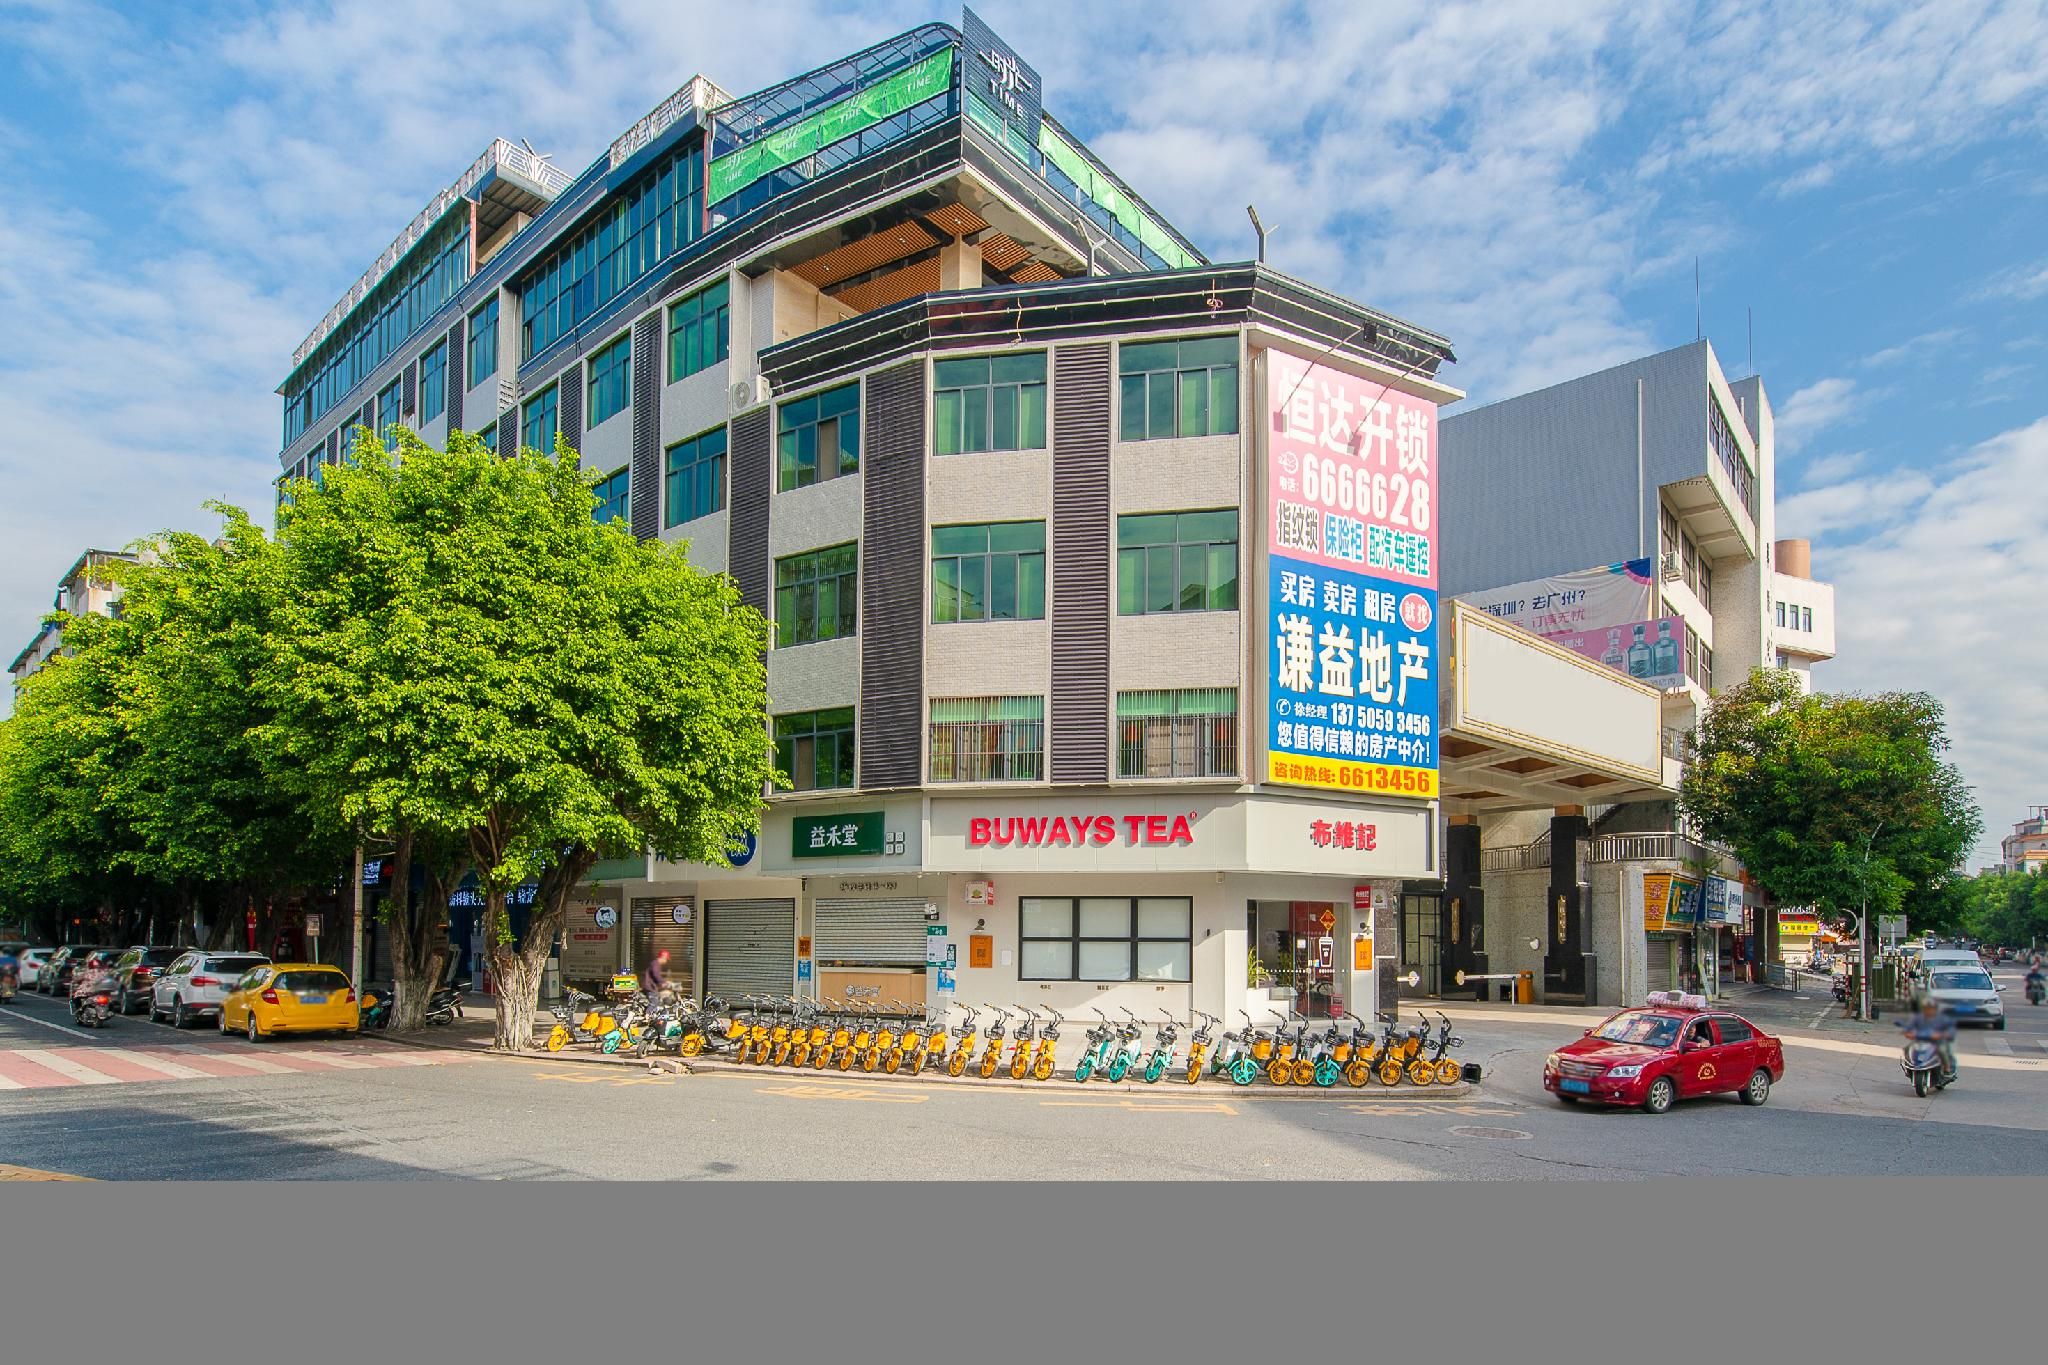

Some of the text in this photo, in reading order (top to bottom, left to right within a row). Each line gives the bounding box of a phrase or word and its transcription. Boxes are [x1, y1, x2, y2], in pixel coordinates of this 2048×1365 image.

[990, 79, 1024, 118] TIME
[1277, 367, 1430, 478] 恒达开锁
[1302, 453, 1431, 531] 6666628
[1277, 499, 1430, 578] 指纹锁 保险柜 配汽车遥控
[1280, 570, 1315, 608] 买房
[1323, 579, 1357, 617] 卖房
[1364, 588, 1396, 623] 租房
[1480, 589, 1586, 617] 深圳? 去广州?
[1276, 613, 1430, 707] 谦益地产
[1293, 701, 1430, 737] 徐经理 137 5059 3456
[1277, 720, 1430, 764] 您值得信赖的房产中介!
[1275, 762, 1430, 793] 咨询热线: 6613456
[810, 824, 858, 848] 益禾堂
[970, 816, 1117, 845] BUWAYS
